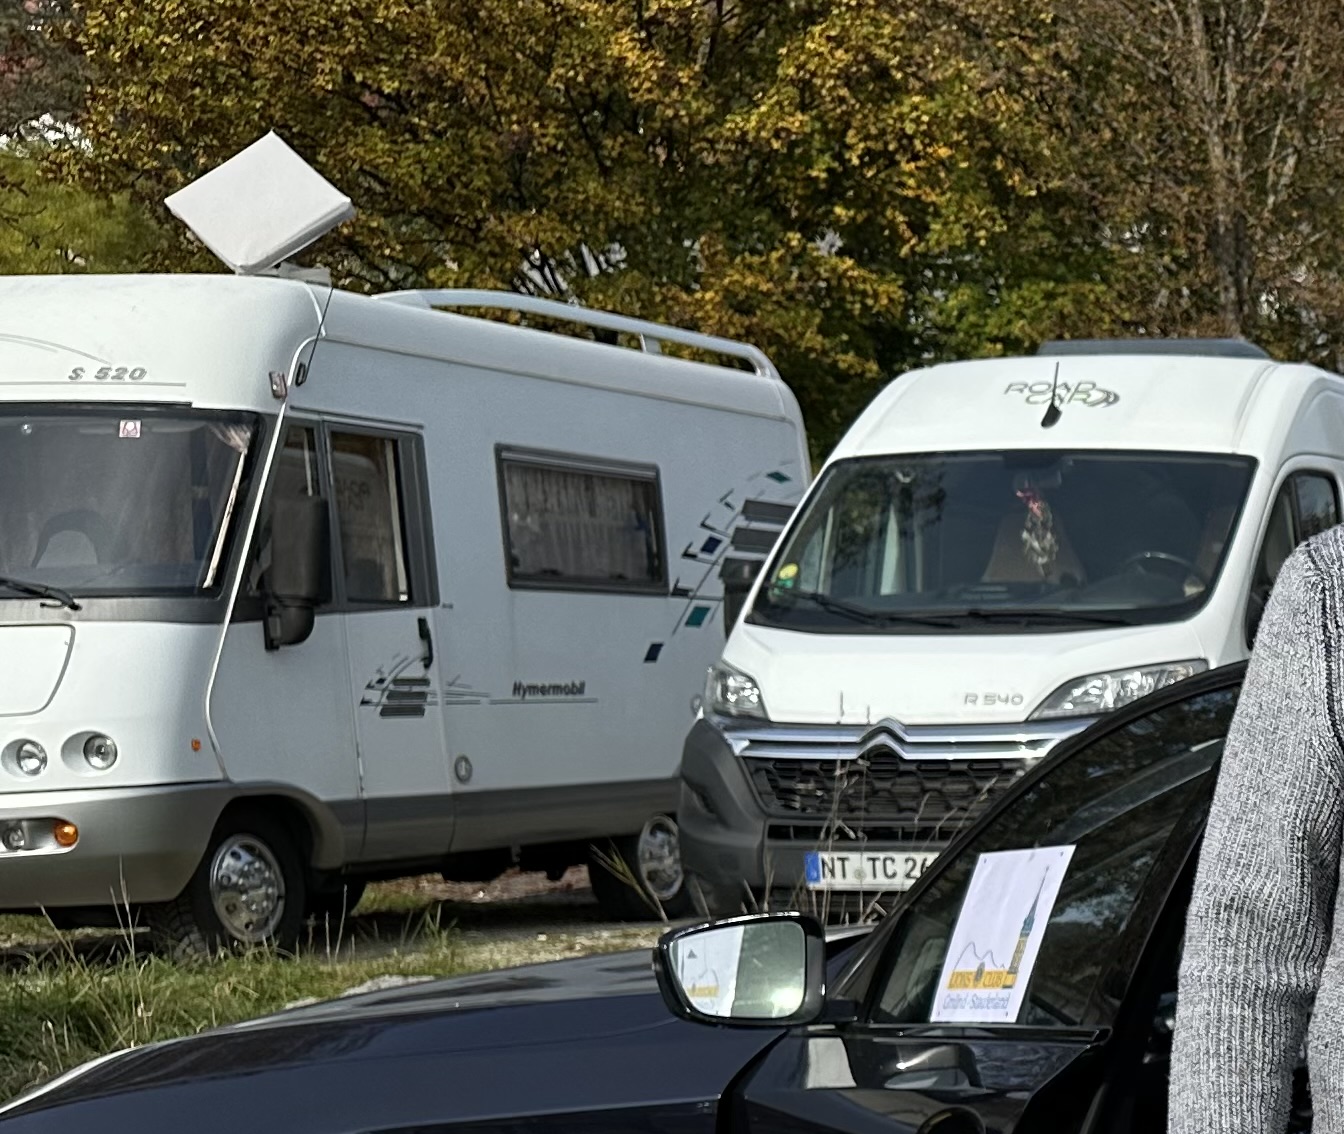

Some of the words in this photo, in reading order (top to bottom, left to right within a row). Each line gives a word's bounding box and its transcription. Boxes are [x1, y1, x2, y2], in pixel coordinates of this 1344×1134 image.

[68, 367, 86, 381] S
[94, 366, 147, 381] 520
[512, 680, 587, 700] Hymermobil
[964, 692, 979, 705] R
[983, 691, 1025, 706] 540
[821, 857, 850, 879] NT
[866, 856, 897, 880] TC
